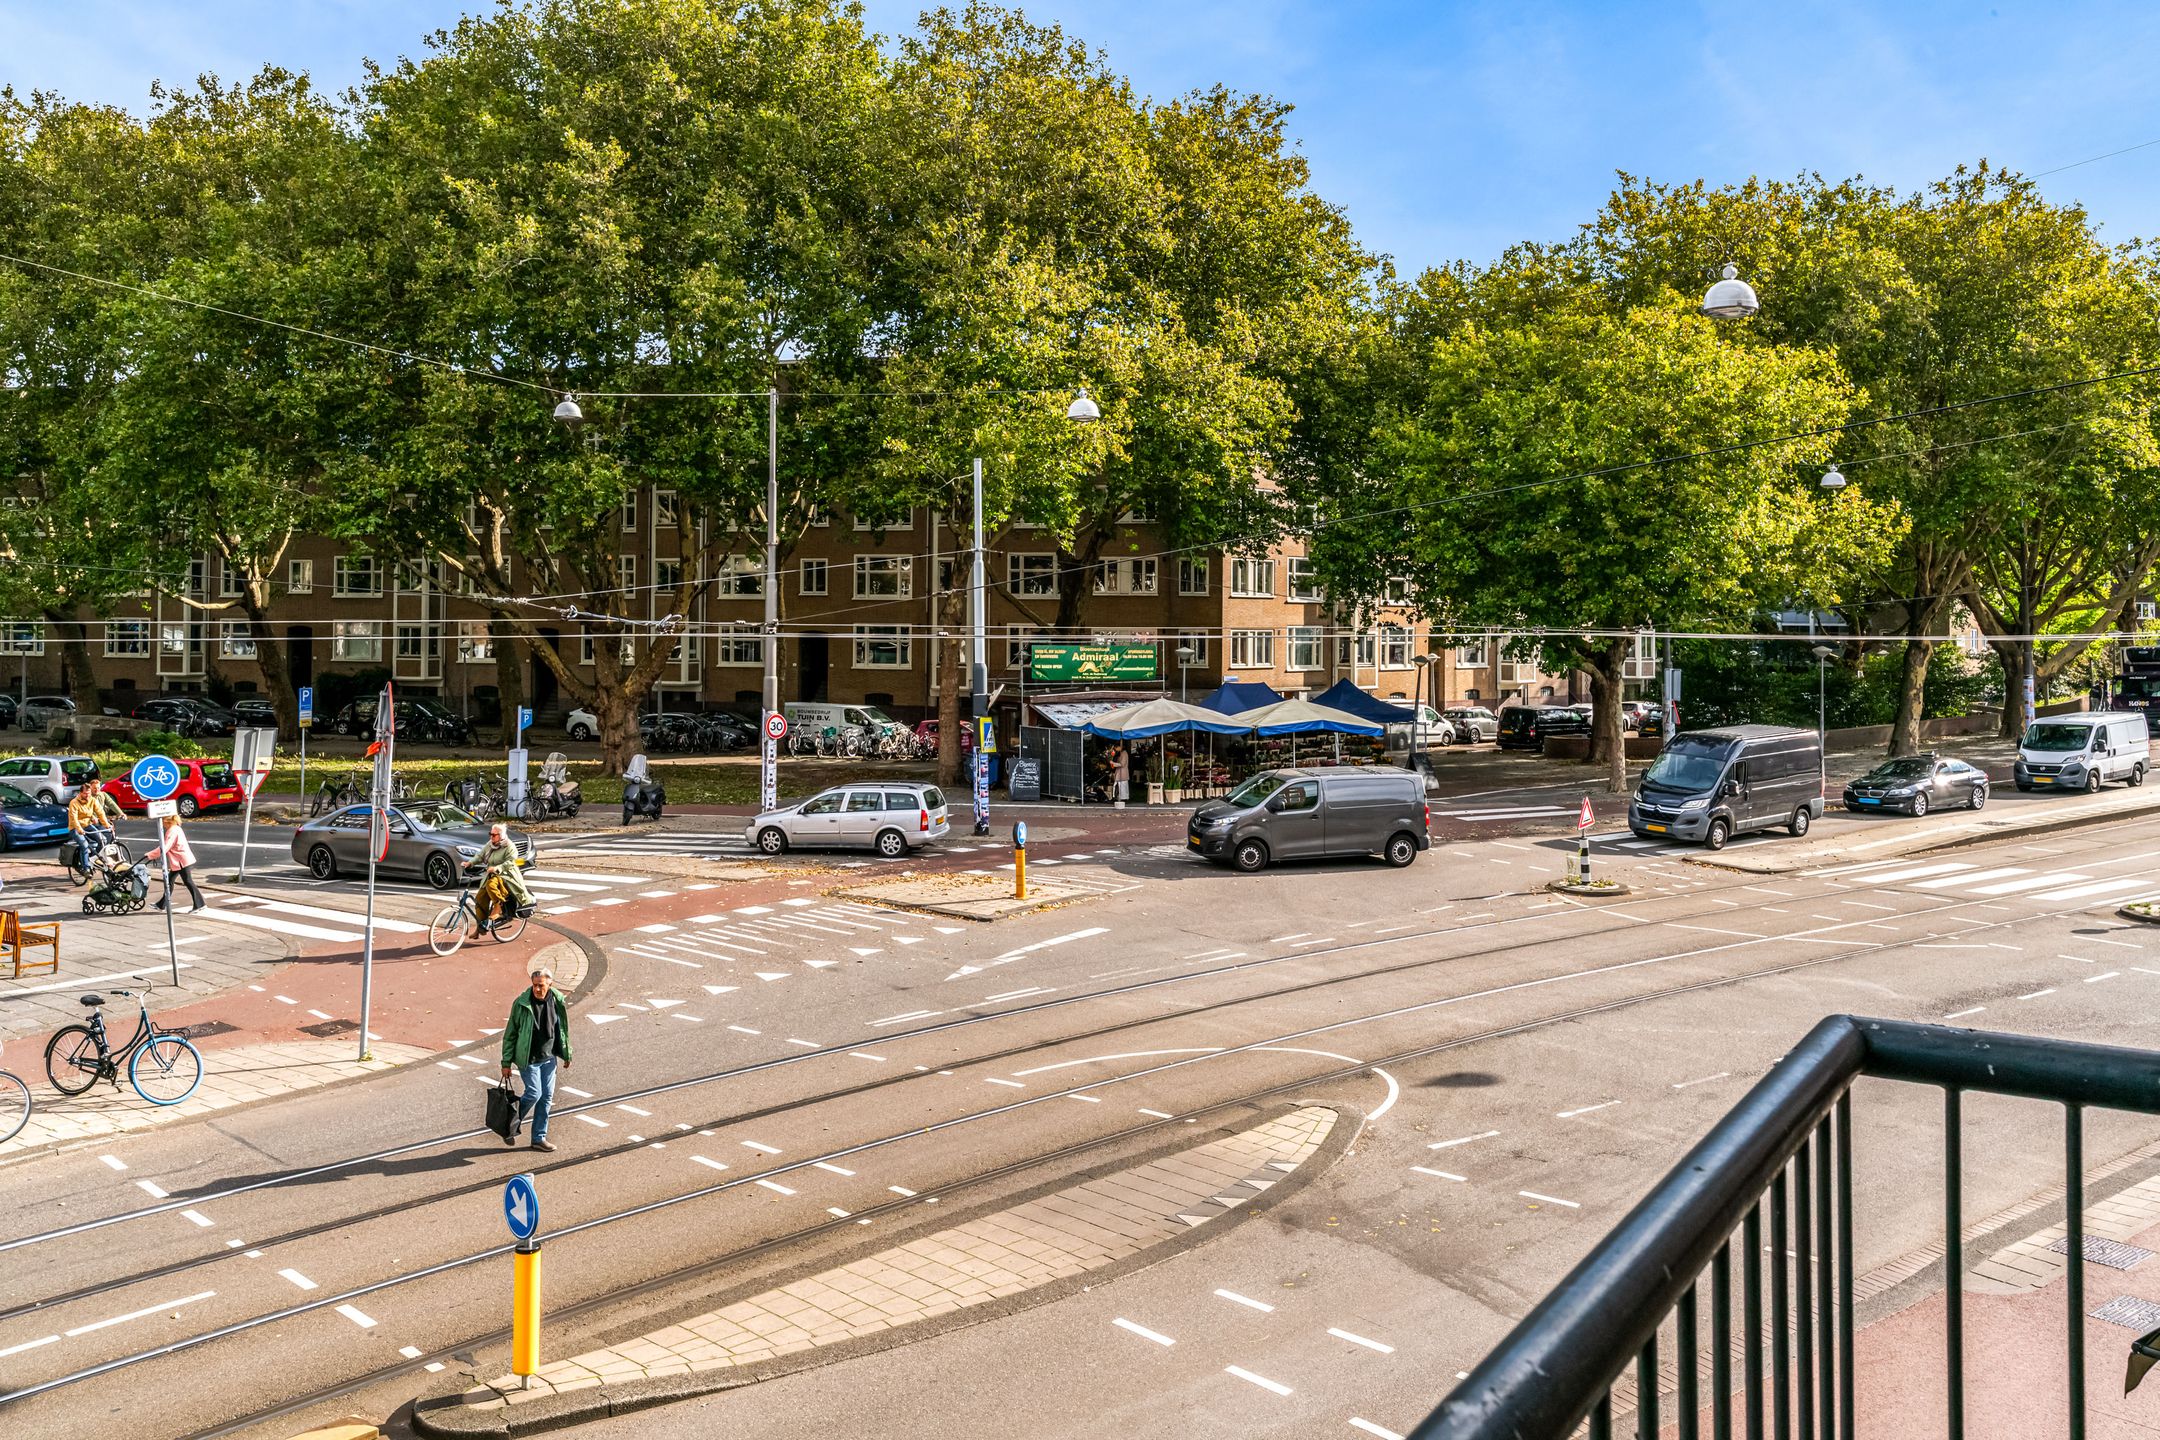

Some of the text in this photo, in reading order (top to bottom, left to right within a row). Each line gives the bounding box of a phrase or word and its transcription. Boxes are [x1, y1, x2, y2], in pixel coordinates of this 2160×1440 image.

[1072, 652, 1119, 661] Admiraal
[302, 690, 310, 702] P
[525, 714, 530, 723] P
[770, 722, 783, 731] 30
